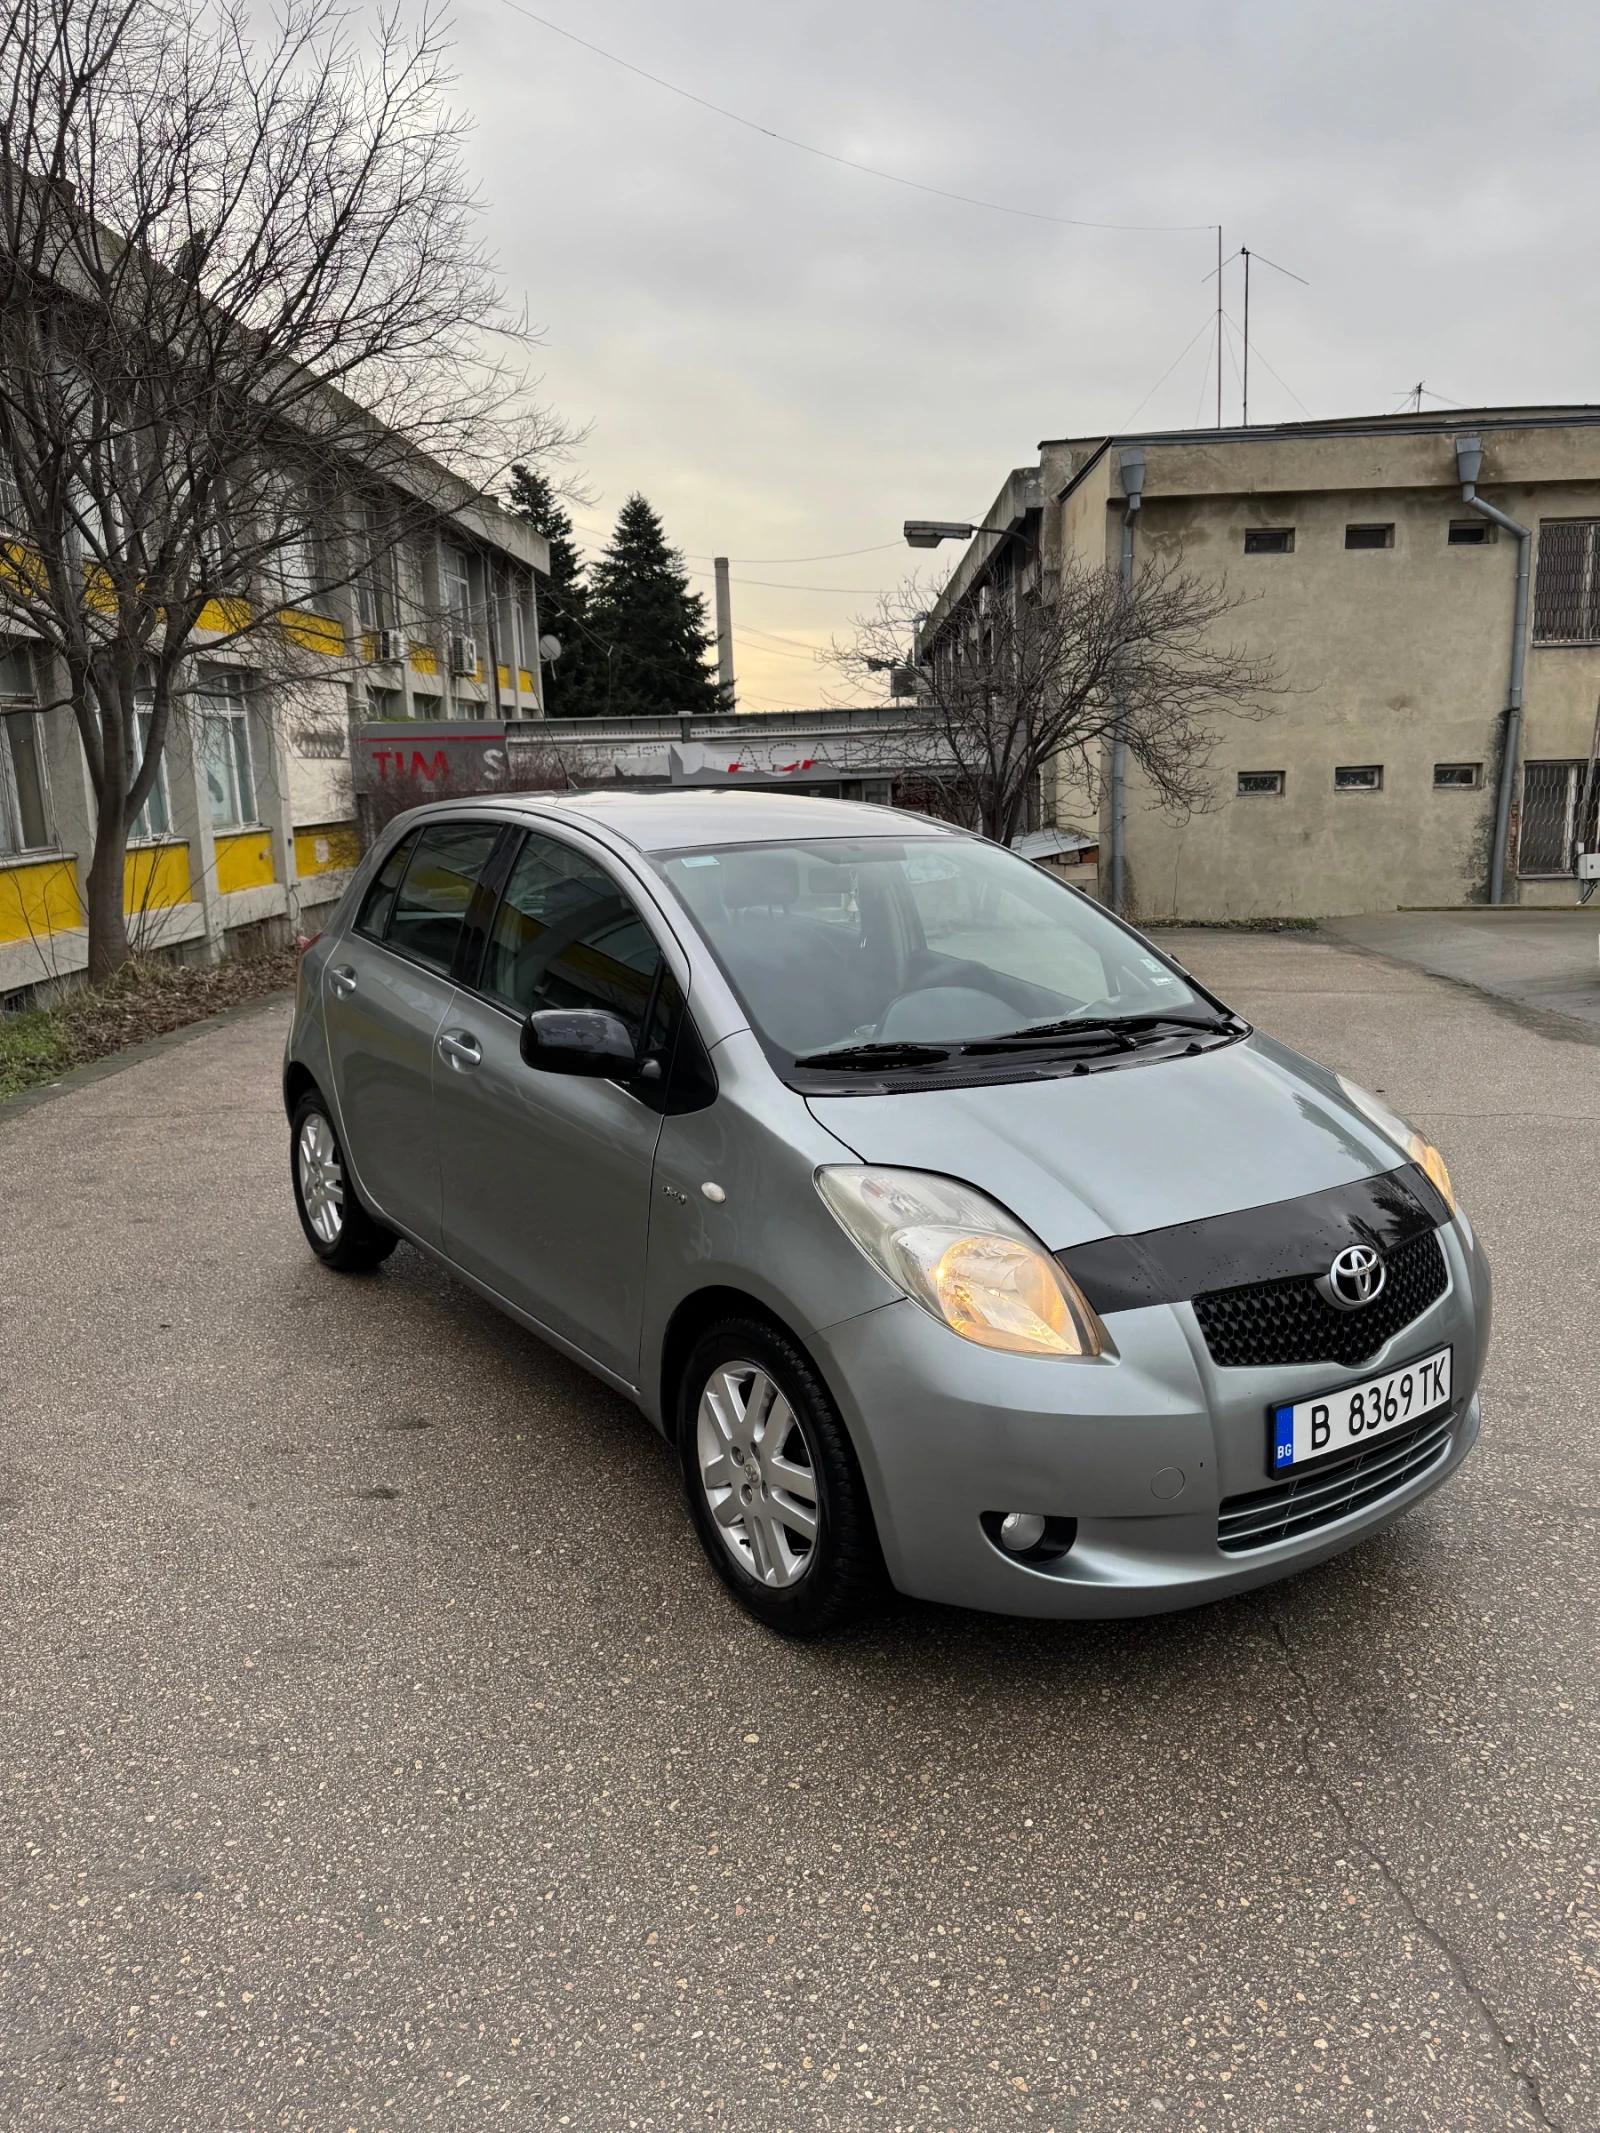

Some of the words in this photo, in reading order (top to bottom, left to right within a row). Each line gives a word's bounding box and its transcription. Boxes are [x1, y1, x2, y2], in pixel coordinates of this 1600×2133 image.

[372, 751, 450, 781] TIM
[1311, 1404, 1331, 1451] B
[1349, 1373, 1414, 1436] 8369
[1419, 1356, 1446, 1406] TK
[1277, 1443, 1292, 1459] BG
